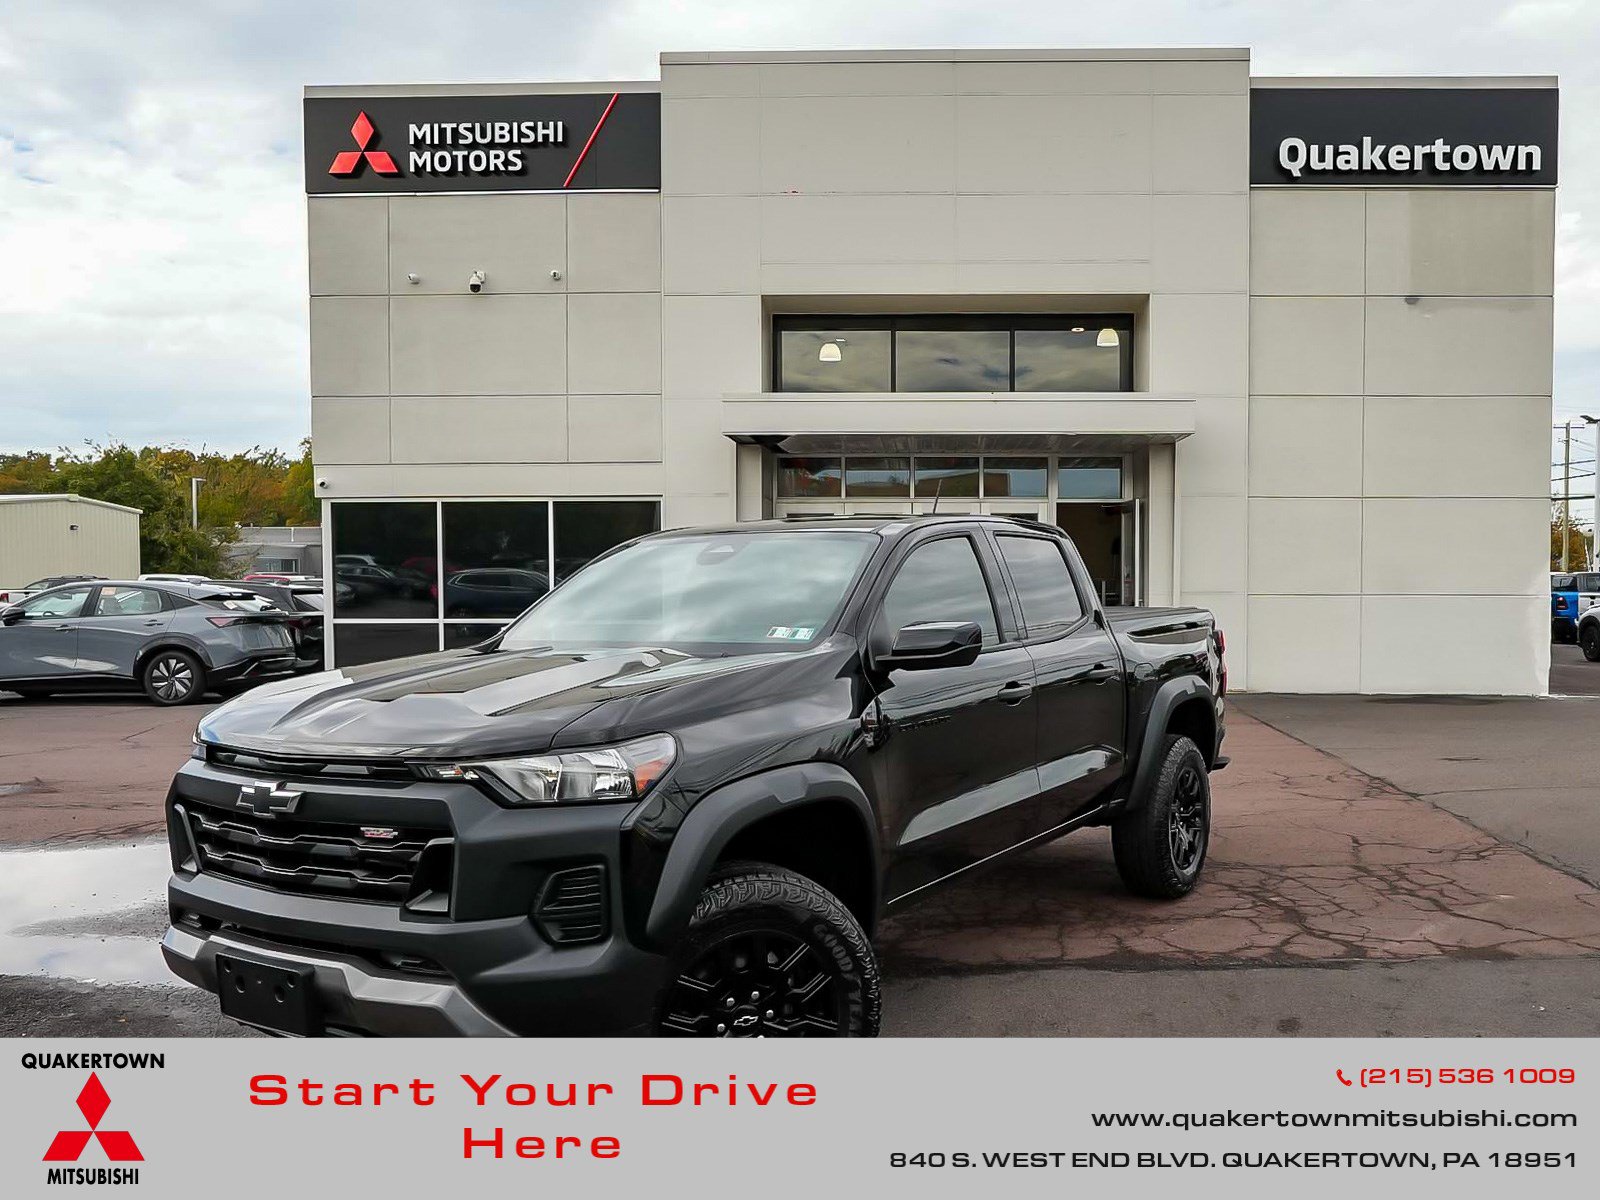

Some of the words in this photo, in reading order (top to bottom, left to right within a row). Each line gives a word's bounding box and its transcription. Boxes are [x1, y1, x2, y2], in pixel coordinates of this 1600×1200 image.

[408, 121, 563, 145] MITSUBISHI
[408, 150, 522, 173] MOTORS
[1279, 136, 1542, 177] Quakertown
